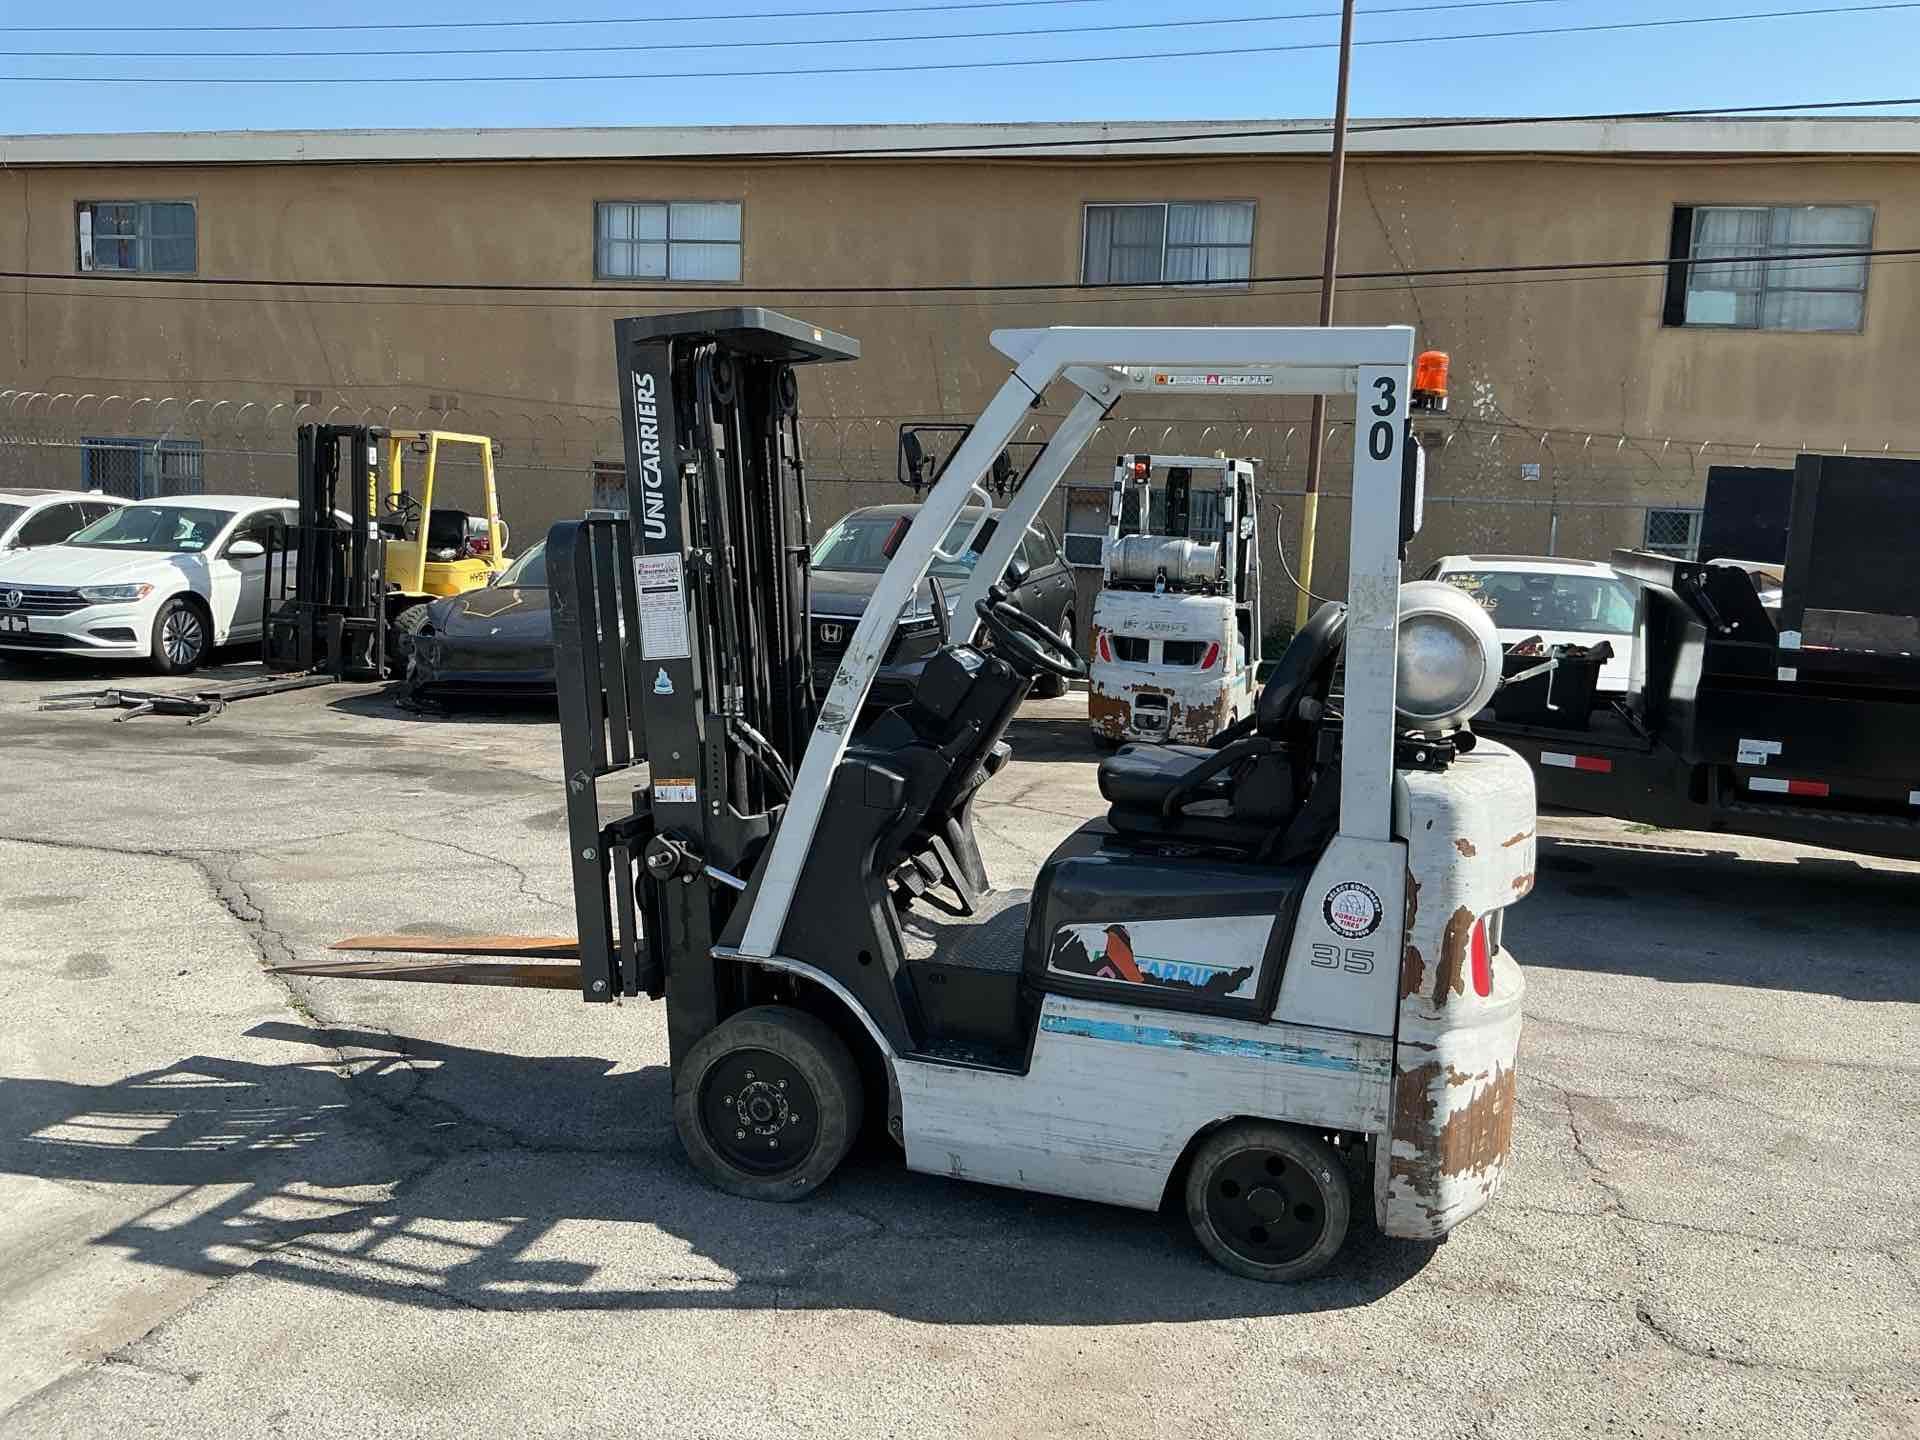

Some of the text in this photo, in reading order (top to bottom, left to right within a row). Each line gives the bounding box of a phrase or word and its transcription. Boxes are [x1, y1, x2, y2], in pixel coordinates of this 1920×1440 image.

[632, 371, 667, 541] UNICARRIERS
[1327, 884, 1381, 912] SELECT EQUIPMENT
[1334, 911, 1369, 924] FORKLIFT
[1339, 919, 1360, 929] TIRES
[1311, 943, 1375, 976] 35
